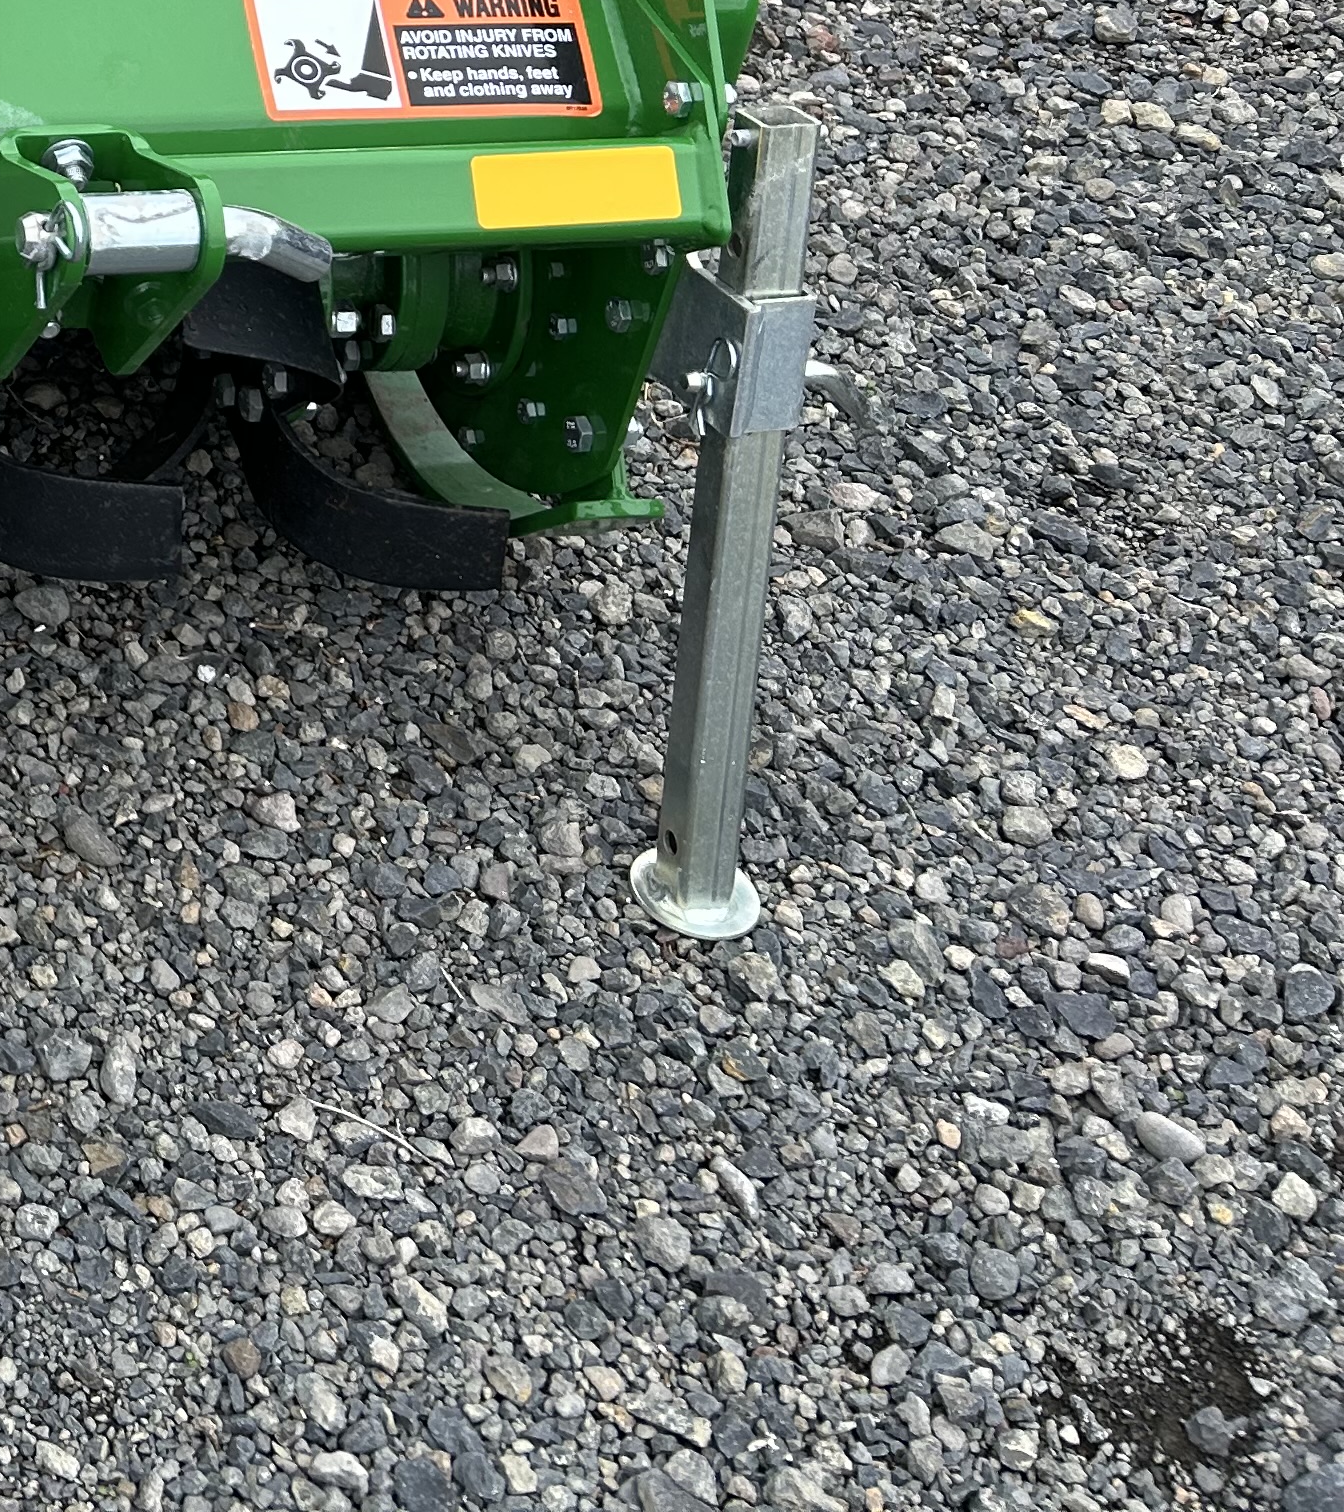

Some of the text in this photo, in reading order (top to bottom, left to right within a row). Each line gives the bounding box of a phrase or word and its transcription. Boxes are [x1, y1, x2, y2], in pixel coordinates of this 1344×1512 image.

[400, 28, 573, 45] AVOID INJURY FROM
[403, 43, 558, 60] ROTATING KNIVES
[420, 66, 559, 84] Keep hands, feet
[423, 82, 573, 99] and clothing away
